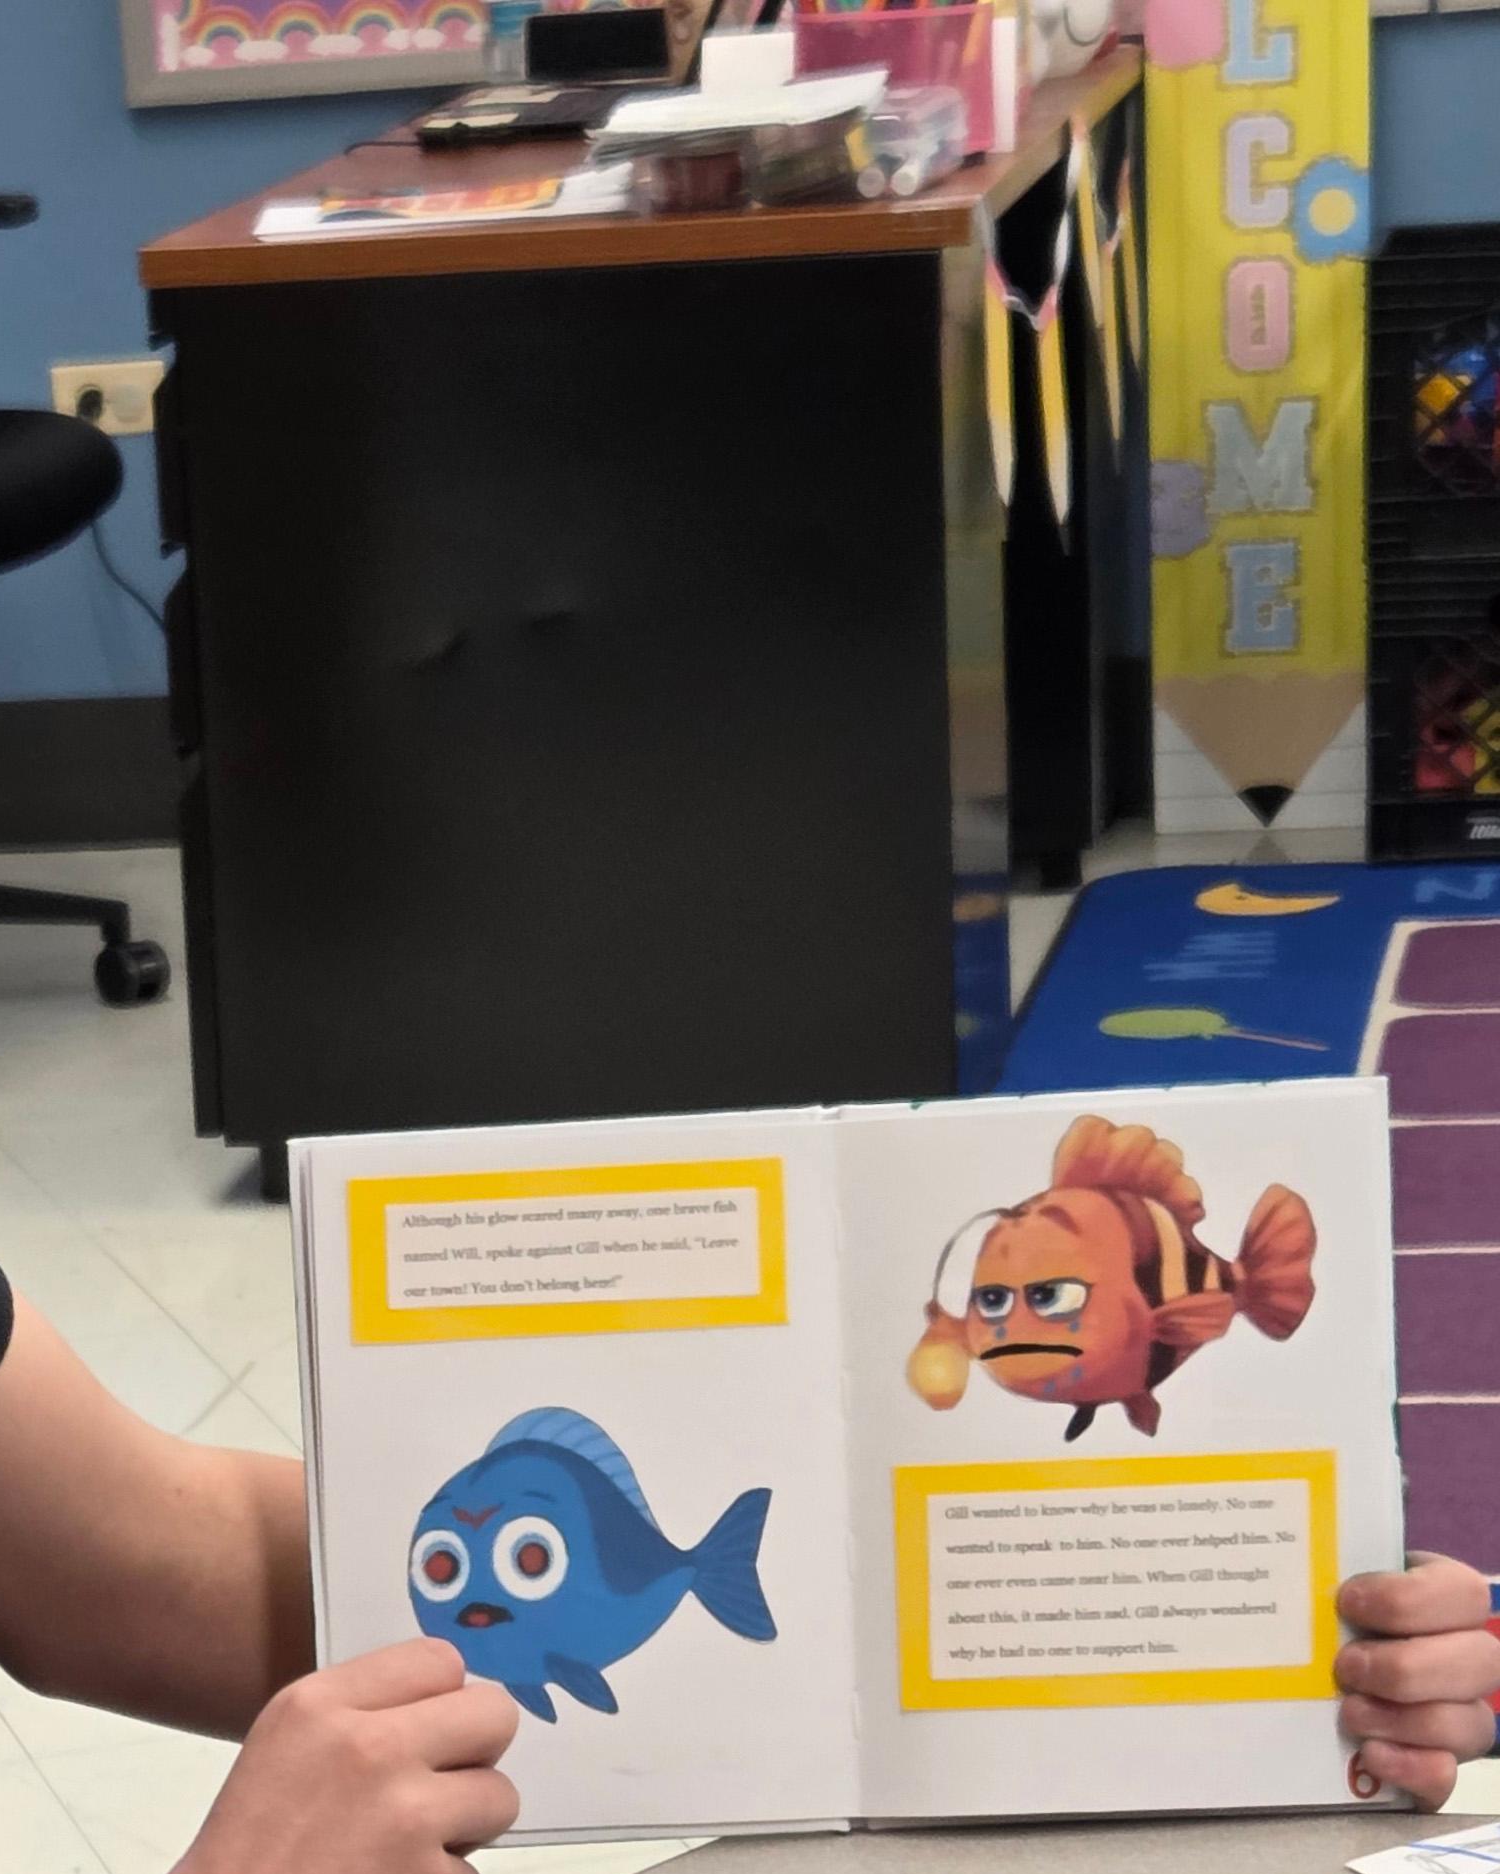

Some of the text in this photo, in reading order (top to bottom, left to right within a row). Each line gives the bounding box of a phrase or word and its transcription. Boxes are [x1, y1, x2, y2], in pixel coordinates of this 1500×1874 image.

[403, 1213, 461, 1228] Although
[466, 1212, 485, 1225] his
[488, 1211, 518, 1226] glow
[522, 1209, 563, 1222] scared
[567, 1209, 603, 1221] many
[646, 1206, 671, 1217] one
[674, 1203, 709, 1215] brave
[714, 1201, 737, 1213] fish
[403, 1248, 448, 1263] named
[486, 1246, 522, 1261] spoke
[527, 1245, 572, 1259] against
[576, 1241, 600, 1254] Gill
[604, 1241, 638, 1253] when
[642, 1239, 658, 1251] he
[403, 1285, 427, 1297] our
[471, 1282, 496, 1294] You
[536, 1278, 580, 1292] belong
[945, 1506, 969, 1519] Gill
[972, 1505, 1021, 1518] wanted
[1024, 1506, 1038, 1517] to
[1041, 1504, 1077, 1516] know
[1080, 1502, 1108, 1516] why
[1112, 1502, 1127, 1514] he
[1130, 1503, 1157, 1513] was
[1160, 1502, 1175, 1512] so
[1226, 1498, 1246, 1510] No
[1249, 1499, 1274, 1509] one
[946, 1541, 994, 1554] wanted
[998, 1542, 1011, 1552] to
[1015, 1539, 1052, 1555] speak
[1060, 1540, 1074, 1551] to
[1111, 1537, 1130, 1549] No
[1133, 1538, 1158, 1548] one
[1161, 1537, 1190, 1547] ever
[1193, 1533, 1239, 1548] helped
[1276, 1531, 1296, 1543] No
[946, 1580, 971, 1590] one
[974, 1579, 1004, 1589] ever
[1006, 1578, 1037, 1588] even
[1040, 1577, 1075, 1586] came
[1079, 1575, 1109, 1585] near
[1146, 1570, 1186, 1583] When
[1189, 1569, 1214, 1582] Gill
[1217, 1568, 1269, 1582] thought
[948, 1611, 986, 1625] about
[1021, 1610, 1031, 1622] it
[1034, 1608, 1071, 1622] made
[1075, 1608, 1101, 1620] him
[1135, 1605, 1159, 1618] Gill
[1162, 1605, 1207, 1620] always
[1210, 1602, 1276, 1615] wondered
[949, 1646, 975, 1662] why
[980, 1646, 996, 1659] he
[1000, 1645, 1025, 1658] had
[1027, 1647, 1045, 1657] no
[1048, 1647, 1073, 1657] one
[1076, 1645, 1090, 1655] to
[1092, 1643, 1144, 1657] support
